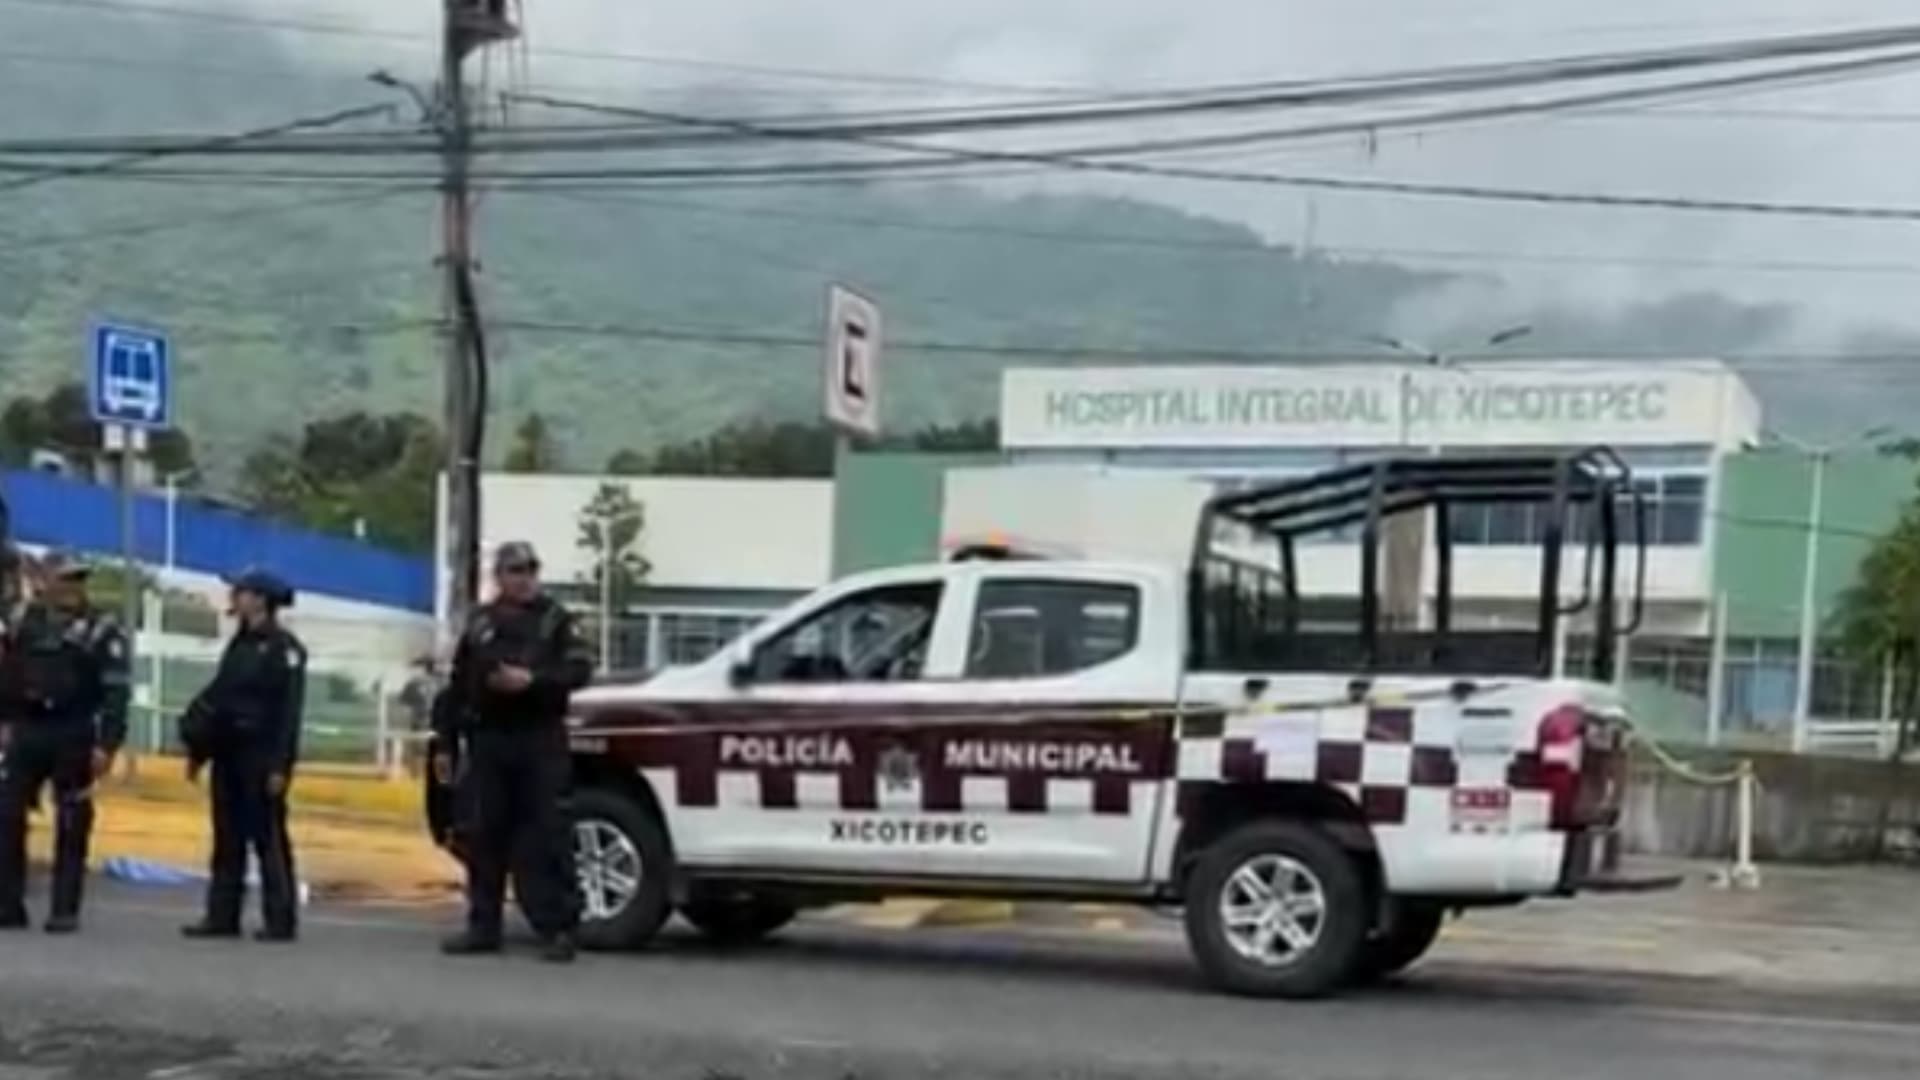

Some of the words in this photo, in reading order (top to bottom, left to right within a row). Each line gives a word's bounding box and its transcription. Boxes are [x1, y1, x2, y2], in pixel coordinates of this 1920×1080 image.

[1044, 388, 1209, 426] HOSPITAL
[1217, 386, 1388, 425] INTEGRAL
[1455, 383, 1667, 422] XICOTEPEC
[719, 733, 854, 767] POLICÍA
[944, 739, 1142, 772] MUNICIPAL
[830, 820, 988, 845] XICOTEPEC
